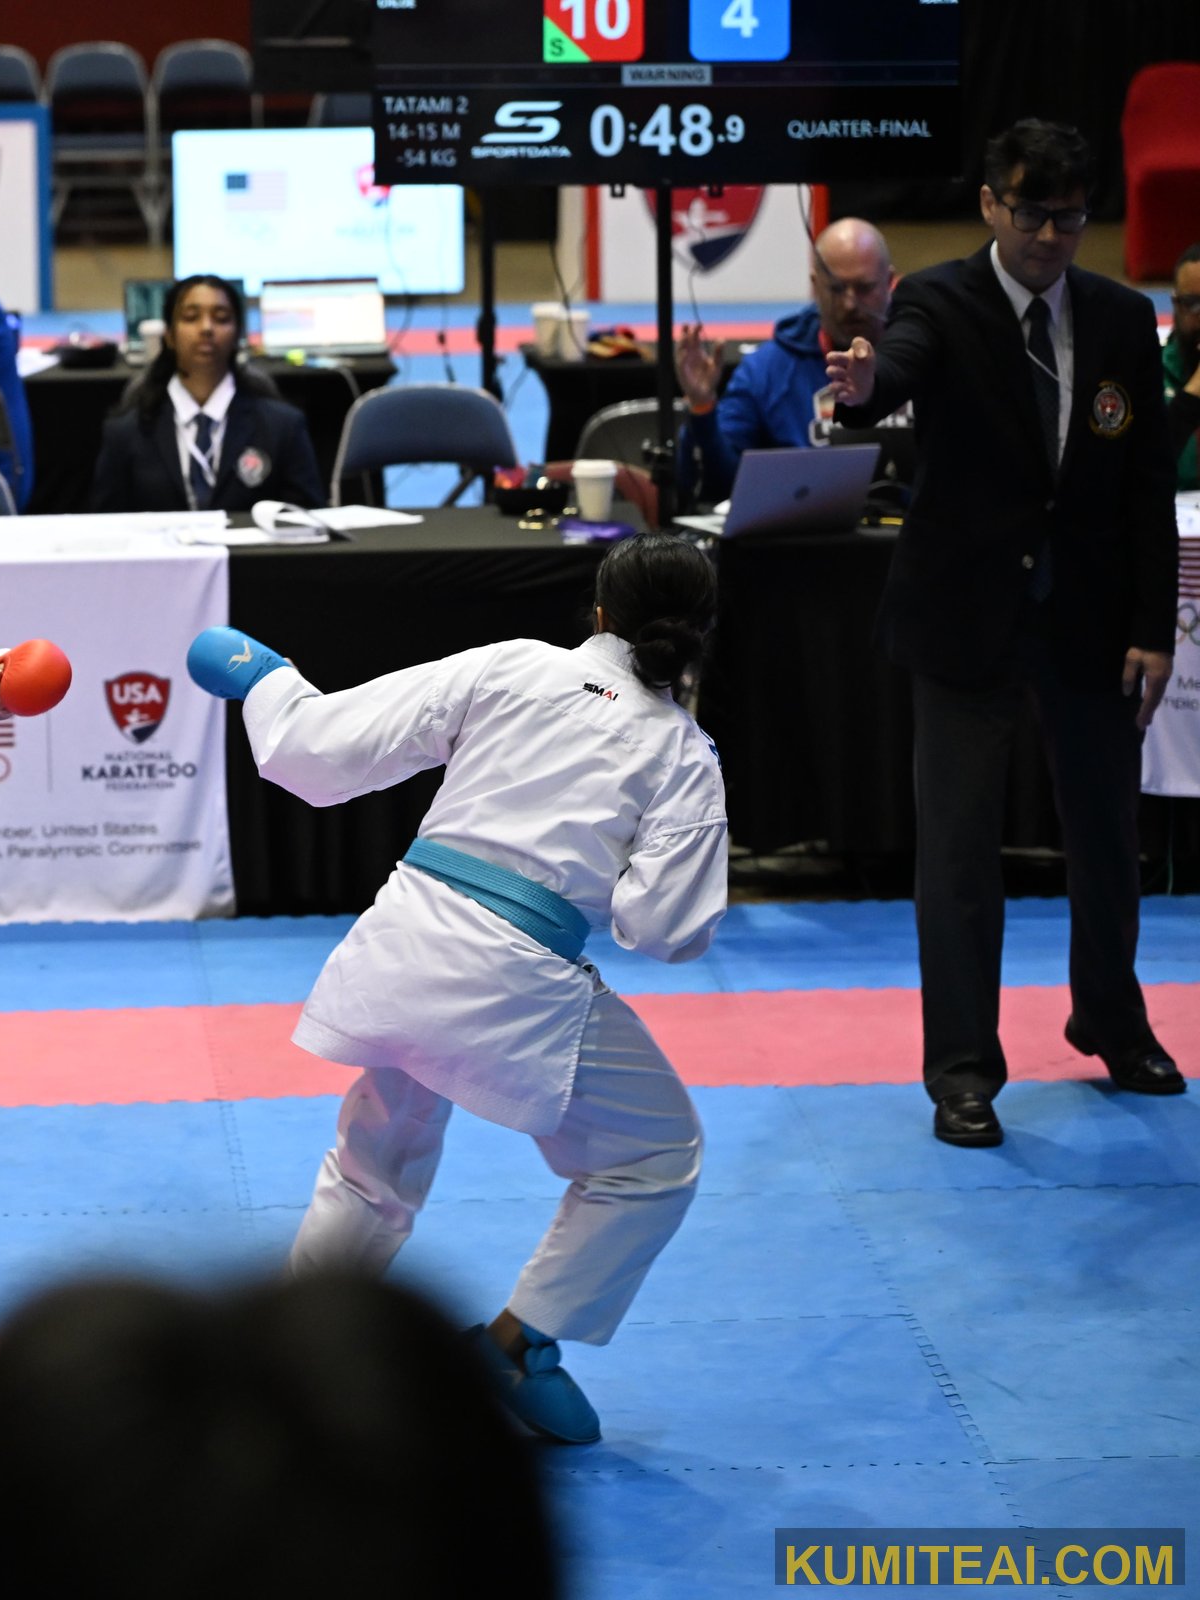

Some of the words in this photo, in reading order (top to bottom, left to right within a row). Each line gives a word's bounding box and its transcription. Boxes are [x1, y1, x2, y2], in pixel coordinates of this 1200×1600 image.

[559, 0, 631, 40] 10
[720, 0, 760, 38] 4
[550, 38, 565, 57] S
[629, 68, 706, 81] WARNING
[383, 96, 452, 115] TATAMI
[456, 96, 469, 114] 2
[387, 123, 438, 141] 14-15
[442, 123, 461, 140] M
[589, 104, 745, 157] 0:48.9
[787, 119, 932, 140] QUARTER-FINAL
[397, 148, 427, 167] -54
[430, 148, 457, 167] KG
[470, 146, 572, 158] SPORTDATA
[111, 682, 164, 705] USA
[582, 682, 619, 701] SMAI
[81, 762, 198, 781] KARATE-DO
[41, 824, 98, 839] United
[103, 822, 158, 837] States
[7, 843, 103, 861] Paralympic
